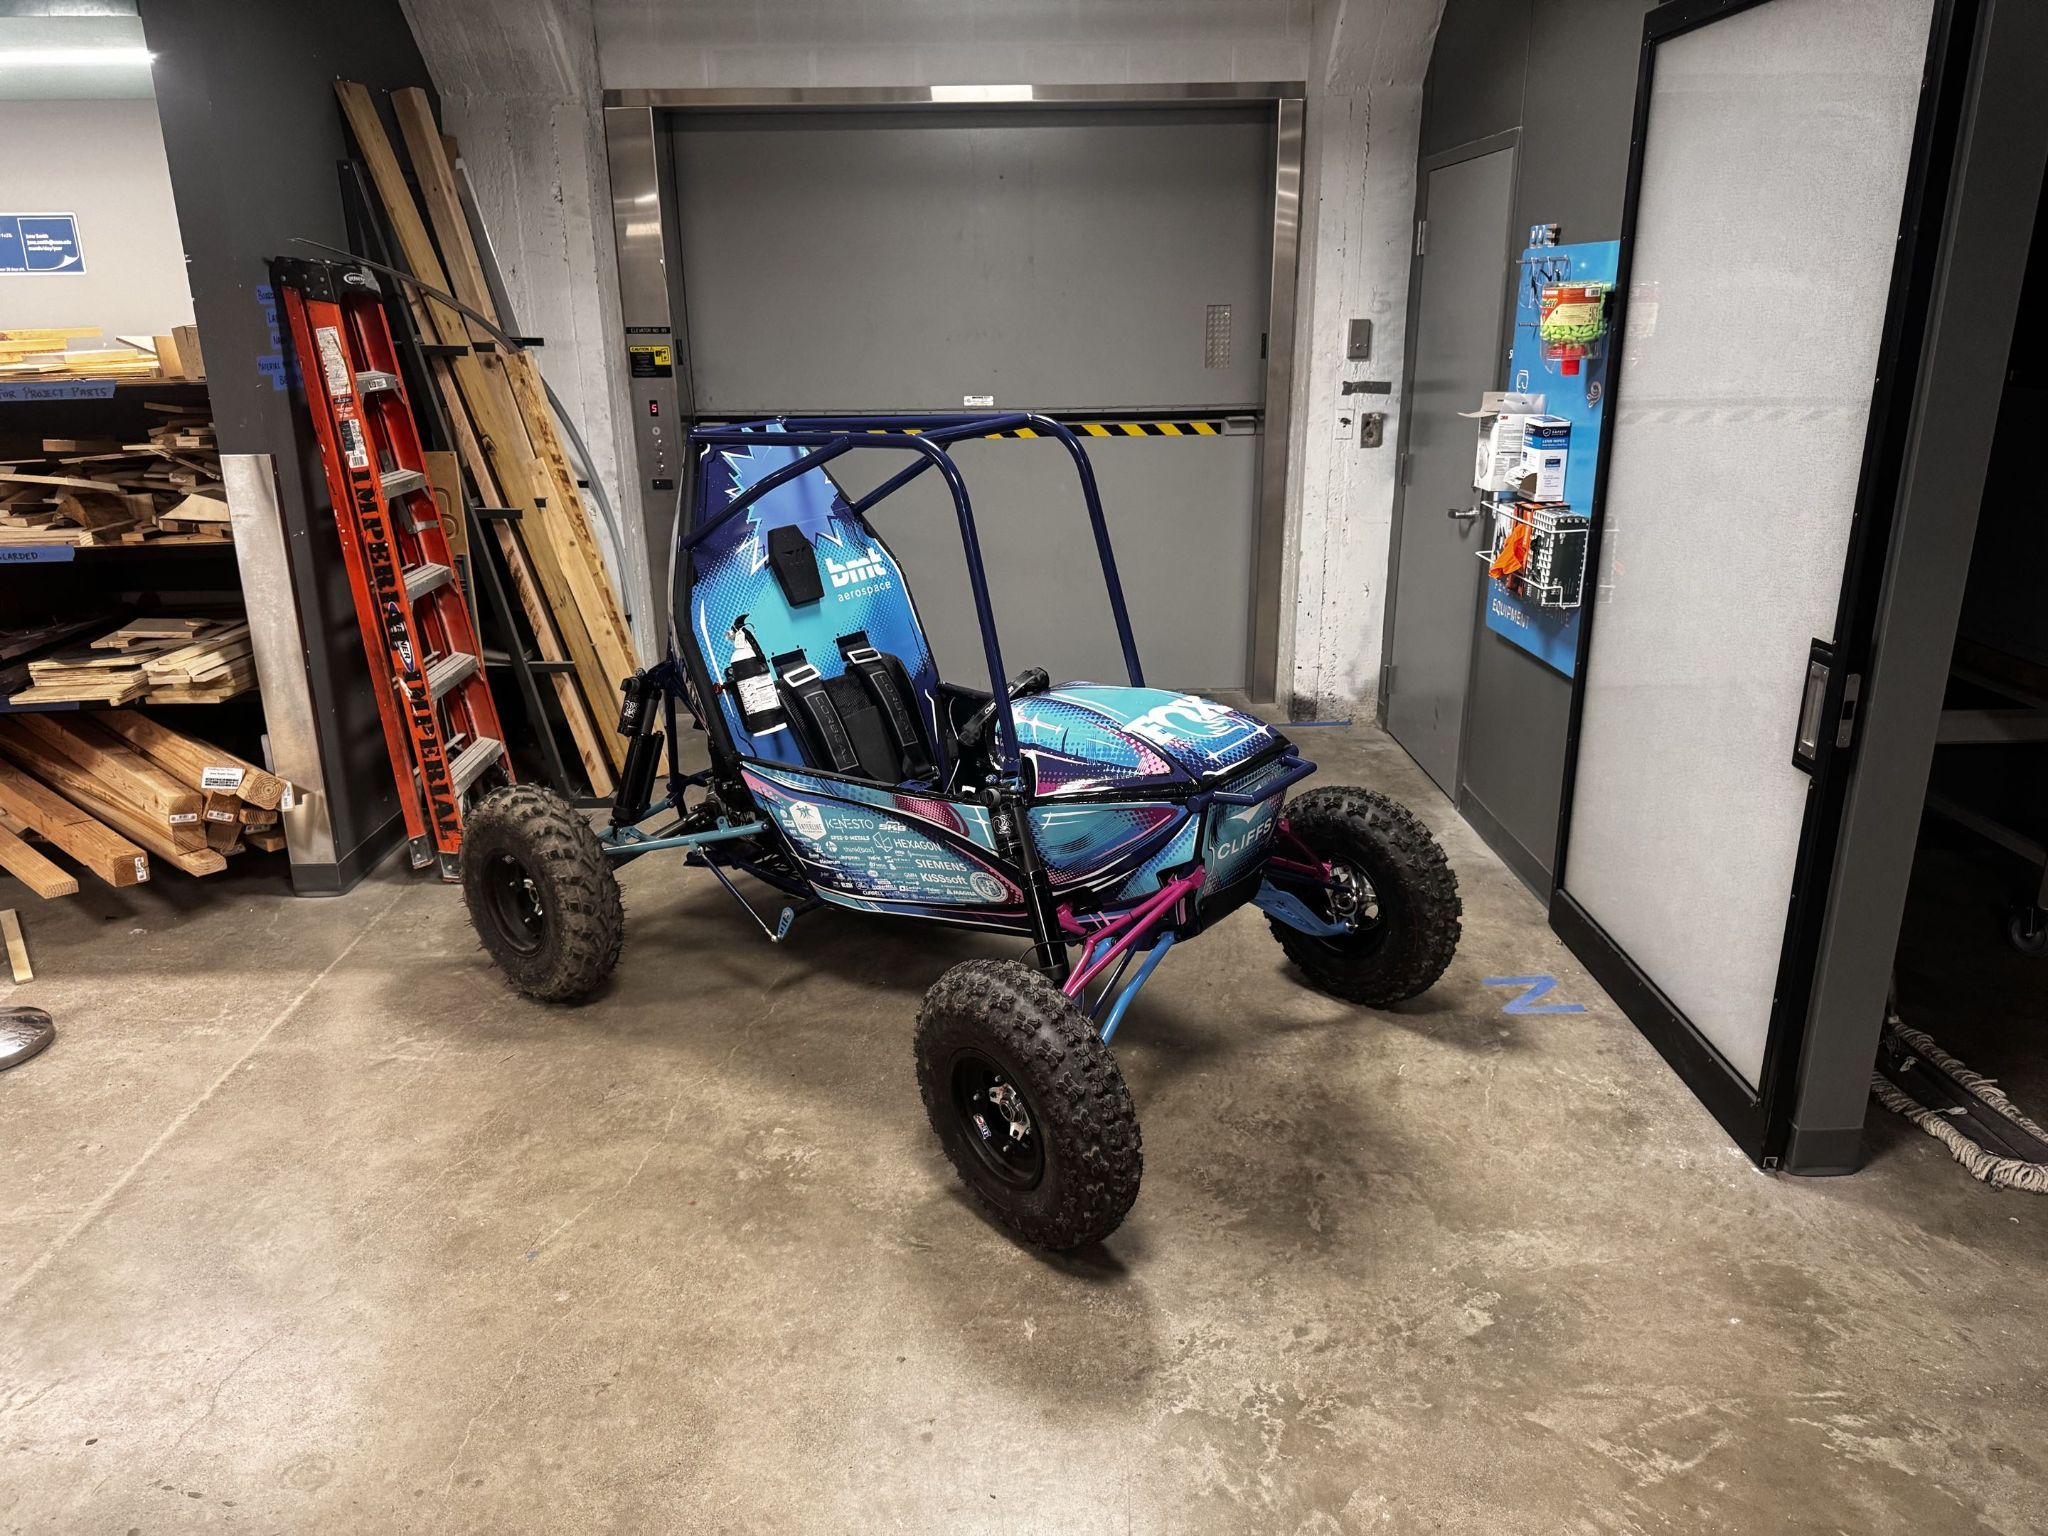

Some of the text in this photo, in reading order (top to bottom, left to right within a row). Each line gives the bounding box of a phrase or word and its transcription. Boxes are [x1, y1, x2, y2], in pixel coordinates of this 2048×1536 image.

[71, 386, 108, 398] PARTS
[825, 547, 887, 588] bmt
[837, 581, 892, 602] aerospace
[1492, 598, 1530, 629] EQUIPMENT
[815, 696, 852, 765] CORBEAU
[1120, 696, 1248, 745] FOX
[405, 671, 460, 841] IMPERIAL
[825, 817, 874, 831] KENESTO
[893, 838, 942, 852] HEXAGON
[1217, 817, 1273, 860] CLIFFS
[915, 859, 968, 872] SIEMENS
[920, 873, 968, 885] KISSsoft
